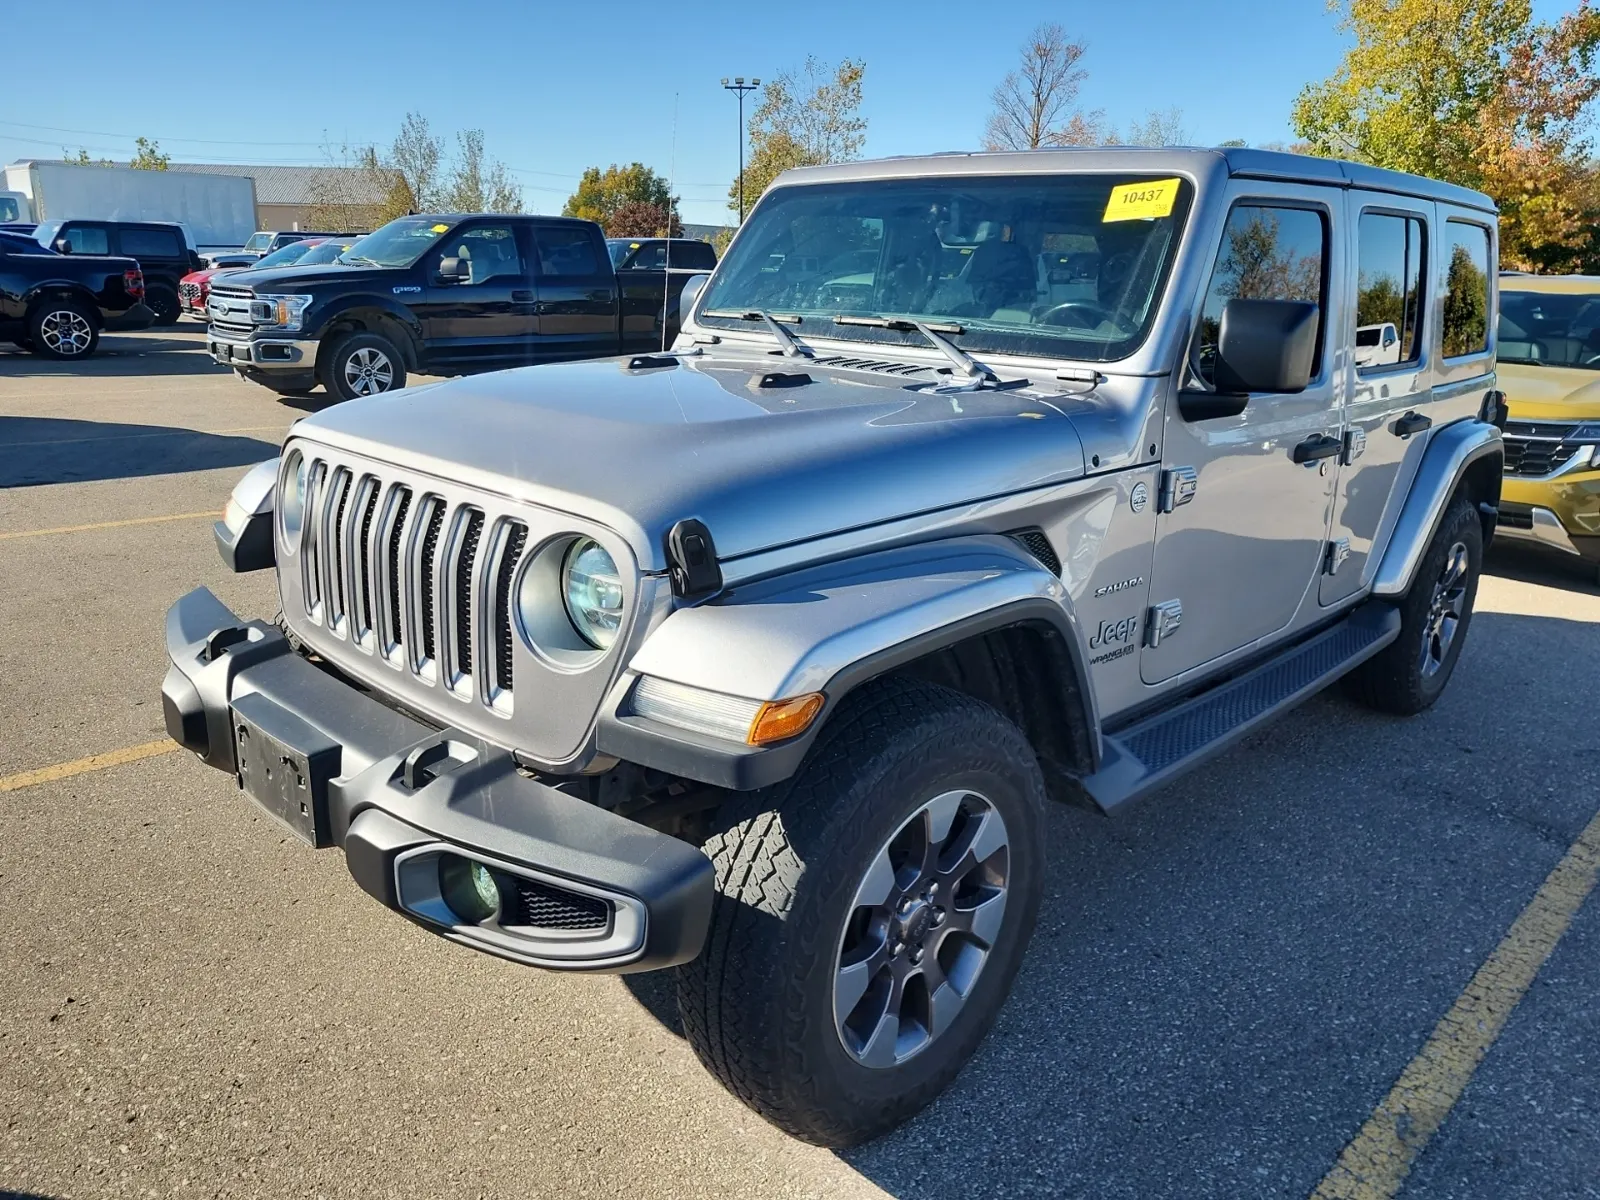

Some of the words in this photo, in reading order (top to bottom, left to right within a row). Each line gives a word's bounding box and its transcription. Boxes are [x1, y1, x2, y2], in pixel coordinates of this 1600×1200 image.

[1122, 189, 1164, 204] 10437
[1094, 576, 1144, 598] SAHARA
[1089, 615, 1138, 650] Jeep
[1088, 643, 1135, 666] WRANGLER
